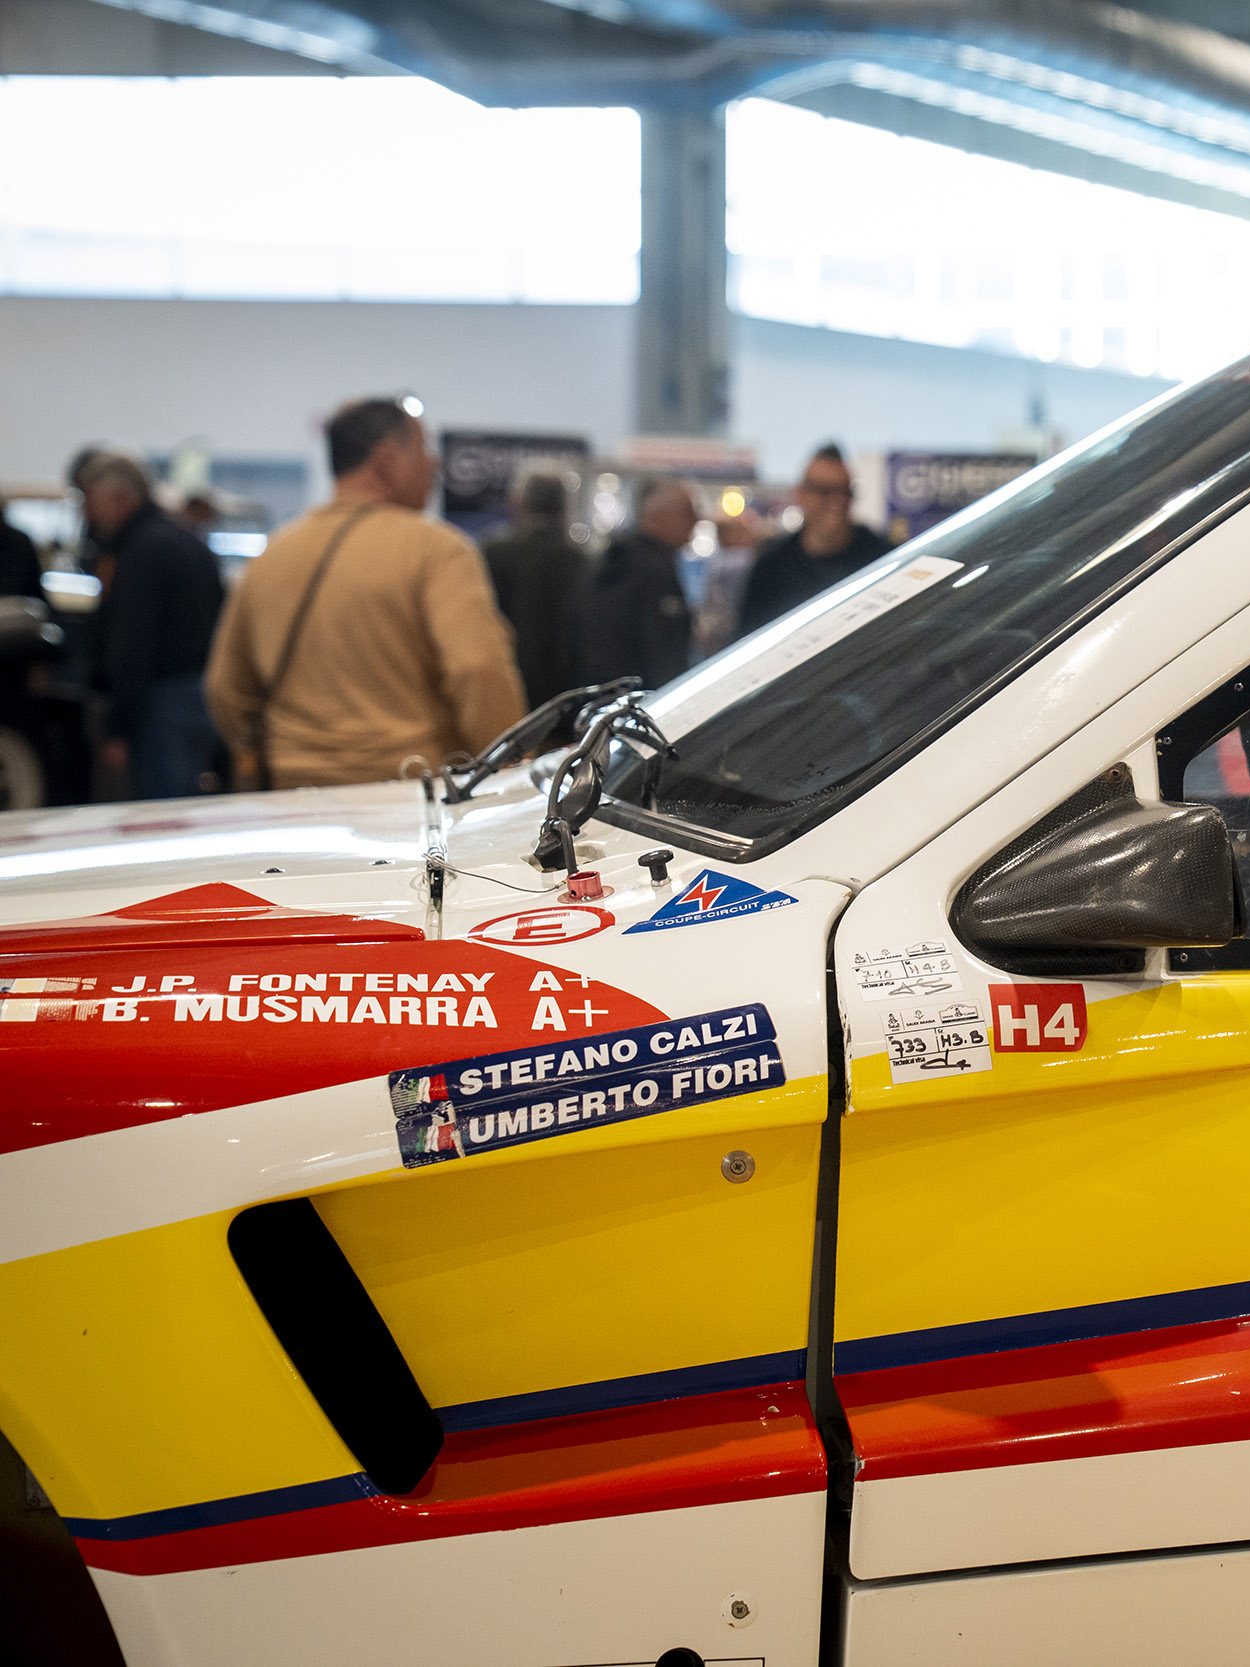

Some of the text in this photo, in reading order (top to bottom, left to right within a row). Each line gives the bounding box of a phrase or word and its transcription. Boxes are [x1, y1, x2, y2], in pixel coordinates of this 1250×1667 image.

[512, 912, 571, 940] E
[654, 901, 760, 927] COUPE-CIRCUIT
[111, 970, 600, 993] J.P. FONTENAY A+
[101, 994, 609, 1032] B. MUSMARRA A+
[997, 1003, 1080, 1047] H4
[459, 1013, 758, 1096] STEFANO CALZI
[891, 1037, 926, 1058] 733
[468, 1053, 769, 1144] UMBERTO FIORI
